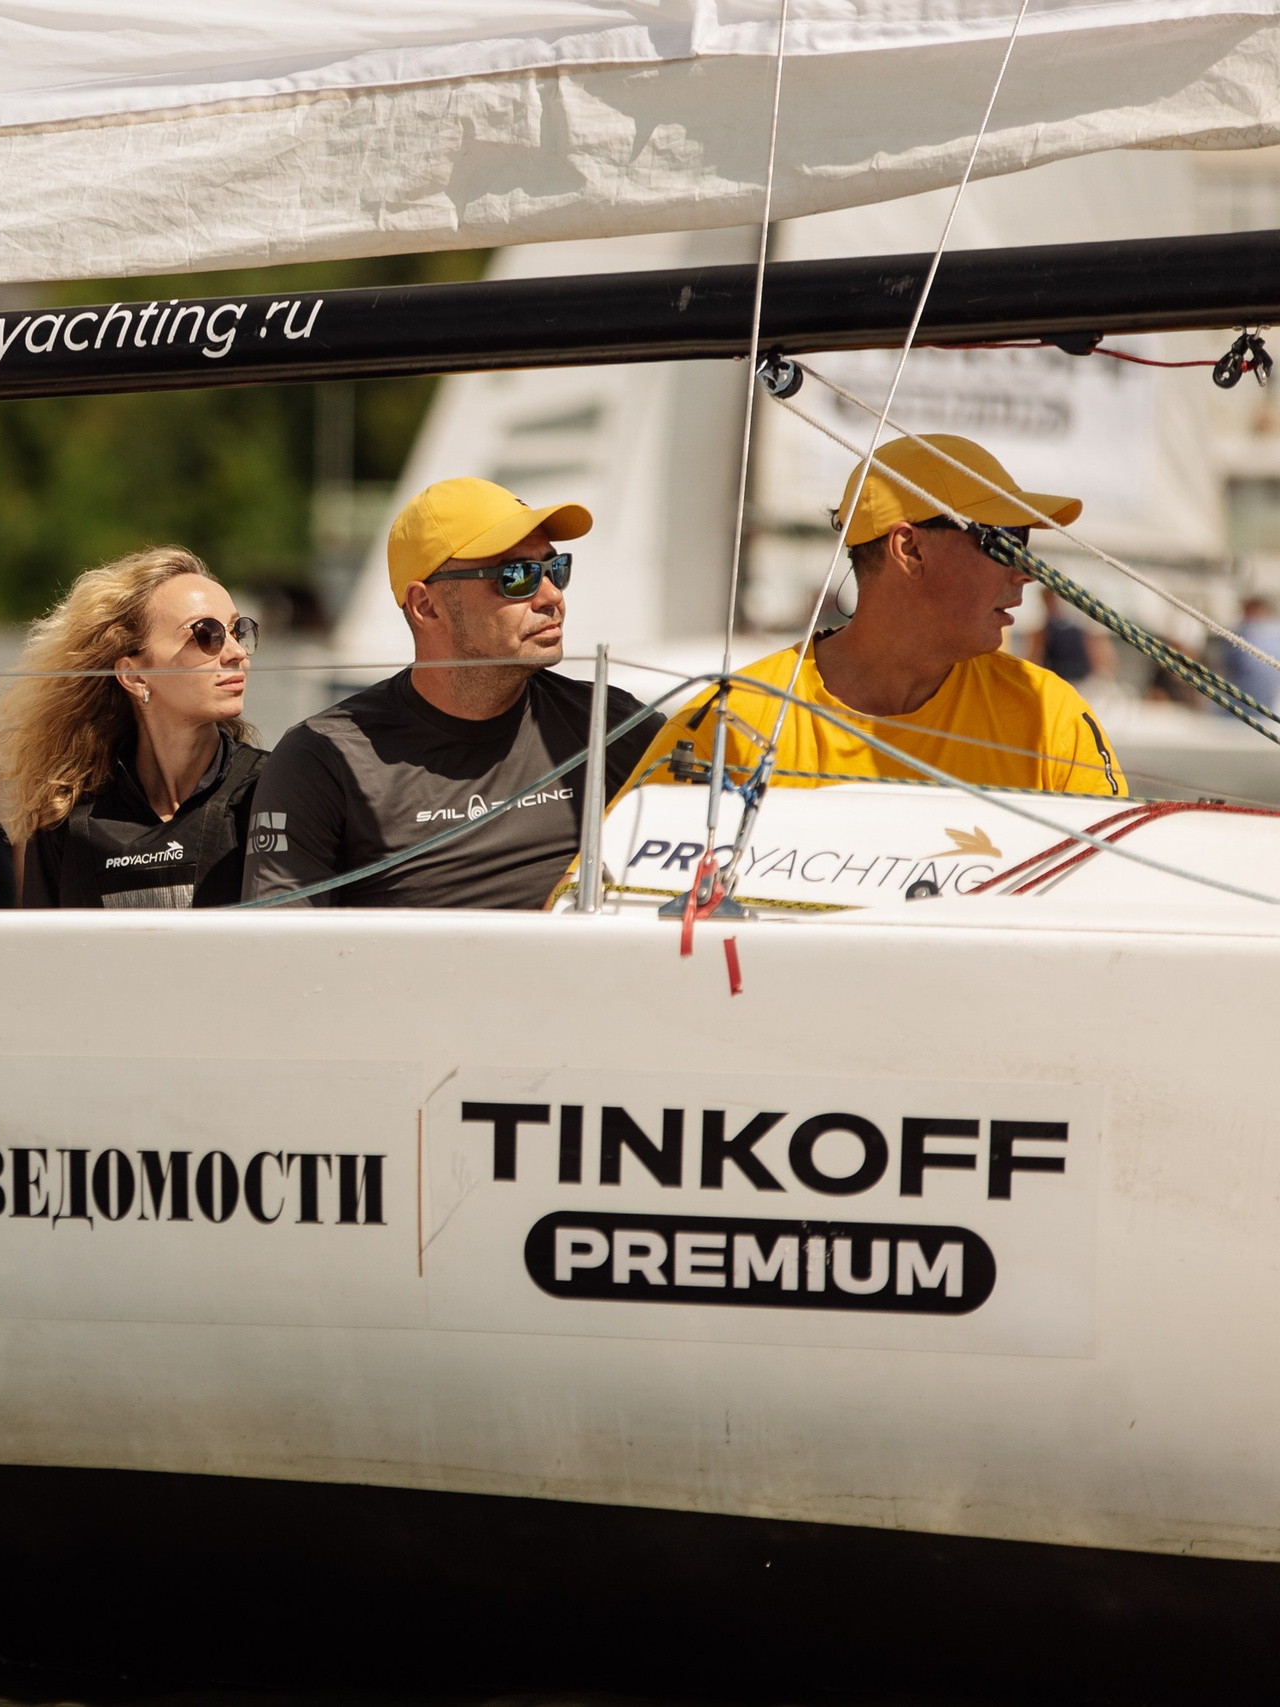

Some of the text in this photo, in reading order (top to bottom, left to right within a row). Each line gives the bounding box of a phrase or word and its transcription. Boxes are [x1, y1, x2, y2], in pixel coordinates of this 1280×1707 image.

[416, 808, 465, 823] SAIL
[105, 849, 184, 869] PROYACHTING
[461, 1101, 1069, 1200] TINKOFF
[554, 1226, 963, 1298] PREMIUM
